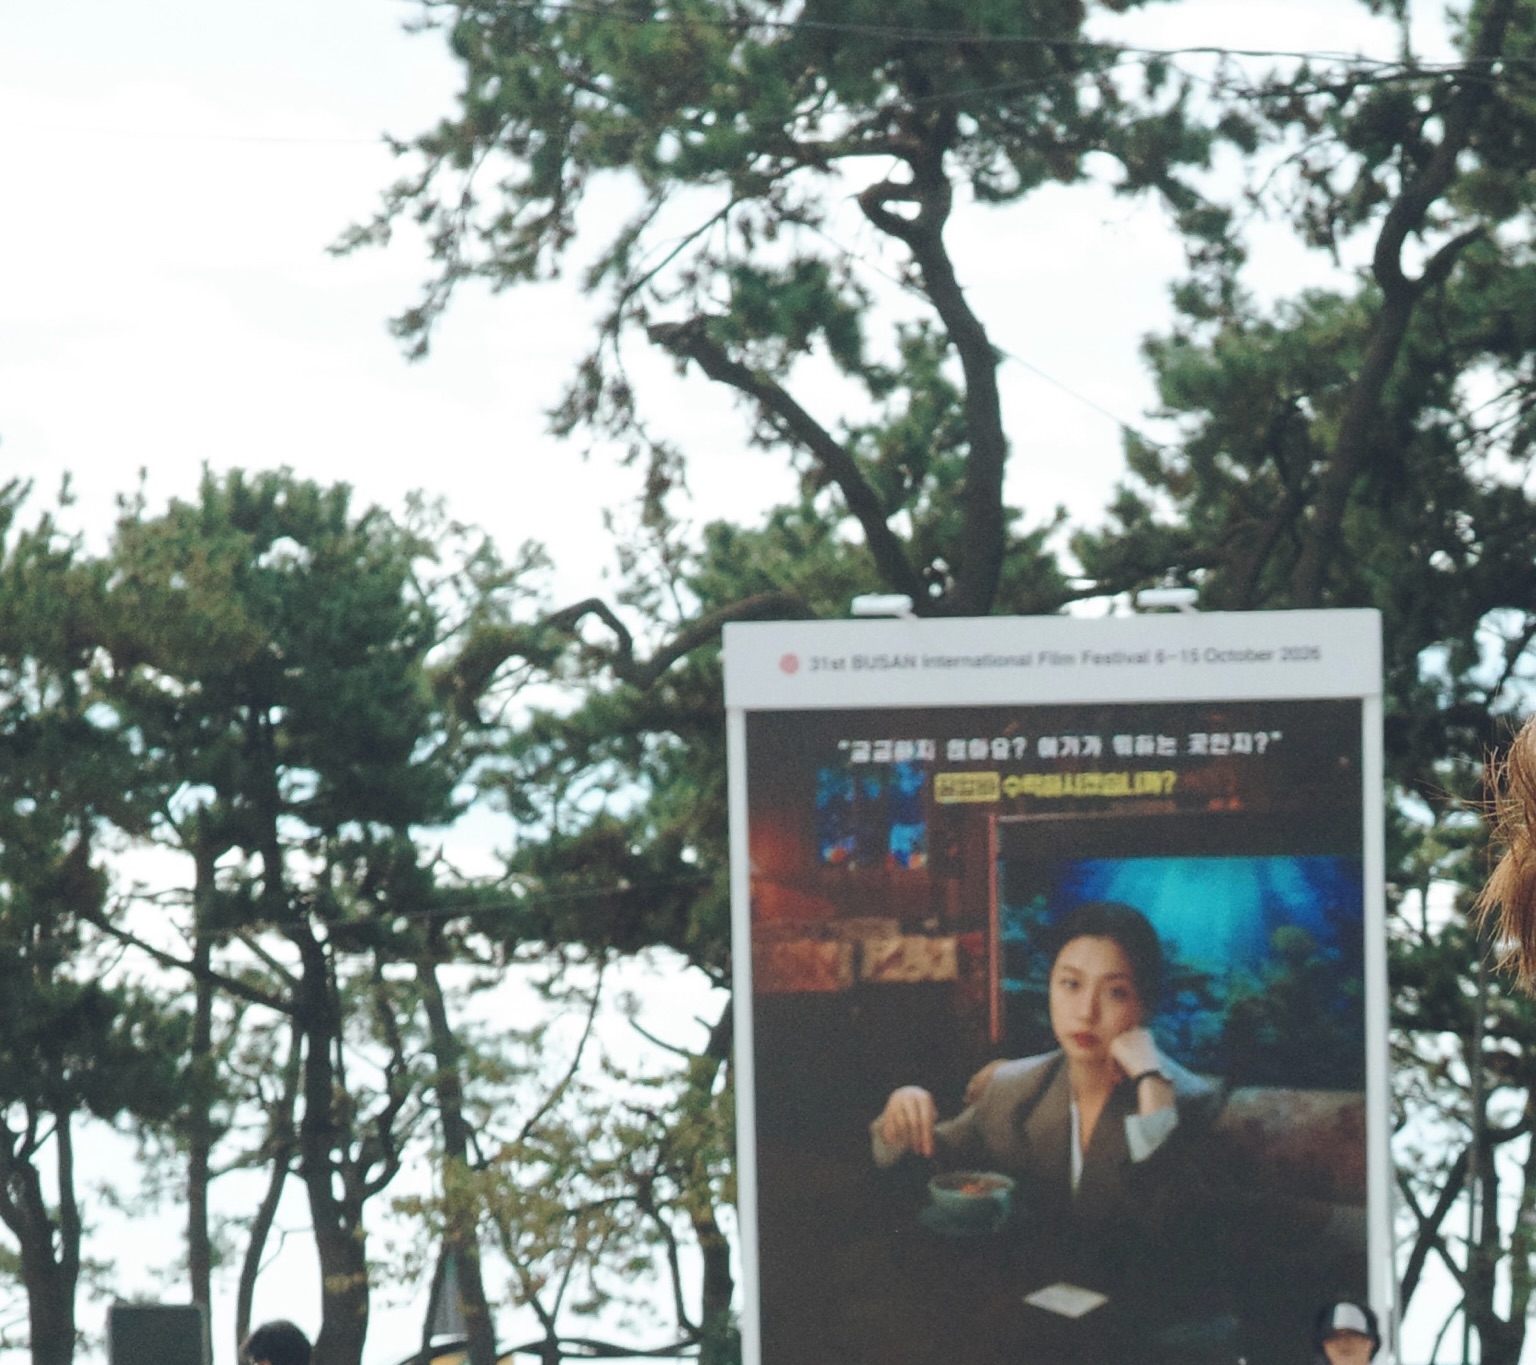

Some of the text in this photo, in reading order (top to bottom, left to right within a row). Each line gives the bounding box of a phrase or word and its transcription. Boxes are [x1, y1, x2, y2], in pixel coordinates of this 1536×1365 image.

[808, 655, 846, 671] 31st
[852, 653, 916, 671] BUSAN
[921, 651, 1034, 669] International
[1037, 650, 1076, 665] Film
[1080, 649, 1148, 665] Festival
[1203, 647, 1272, 664] October
